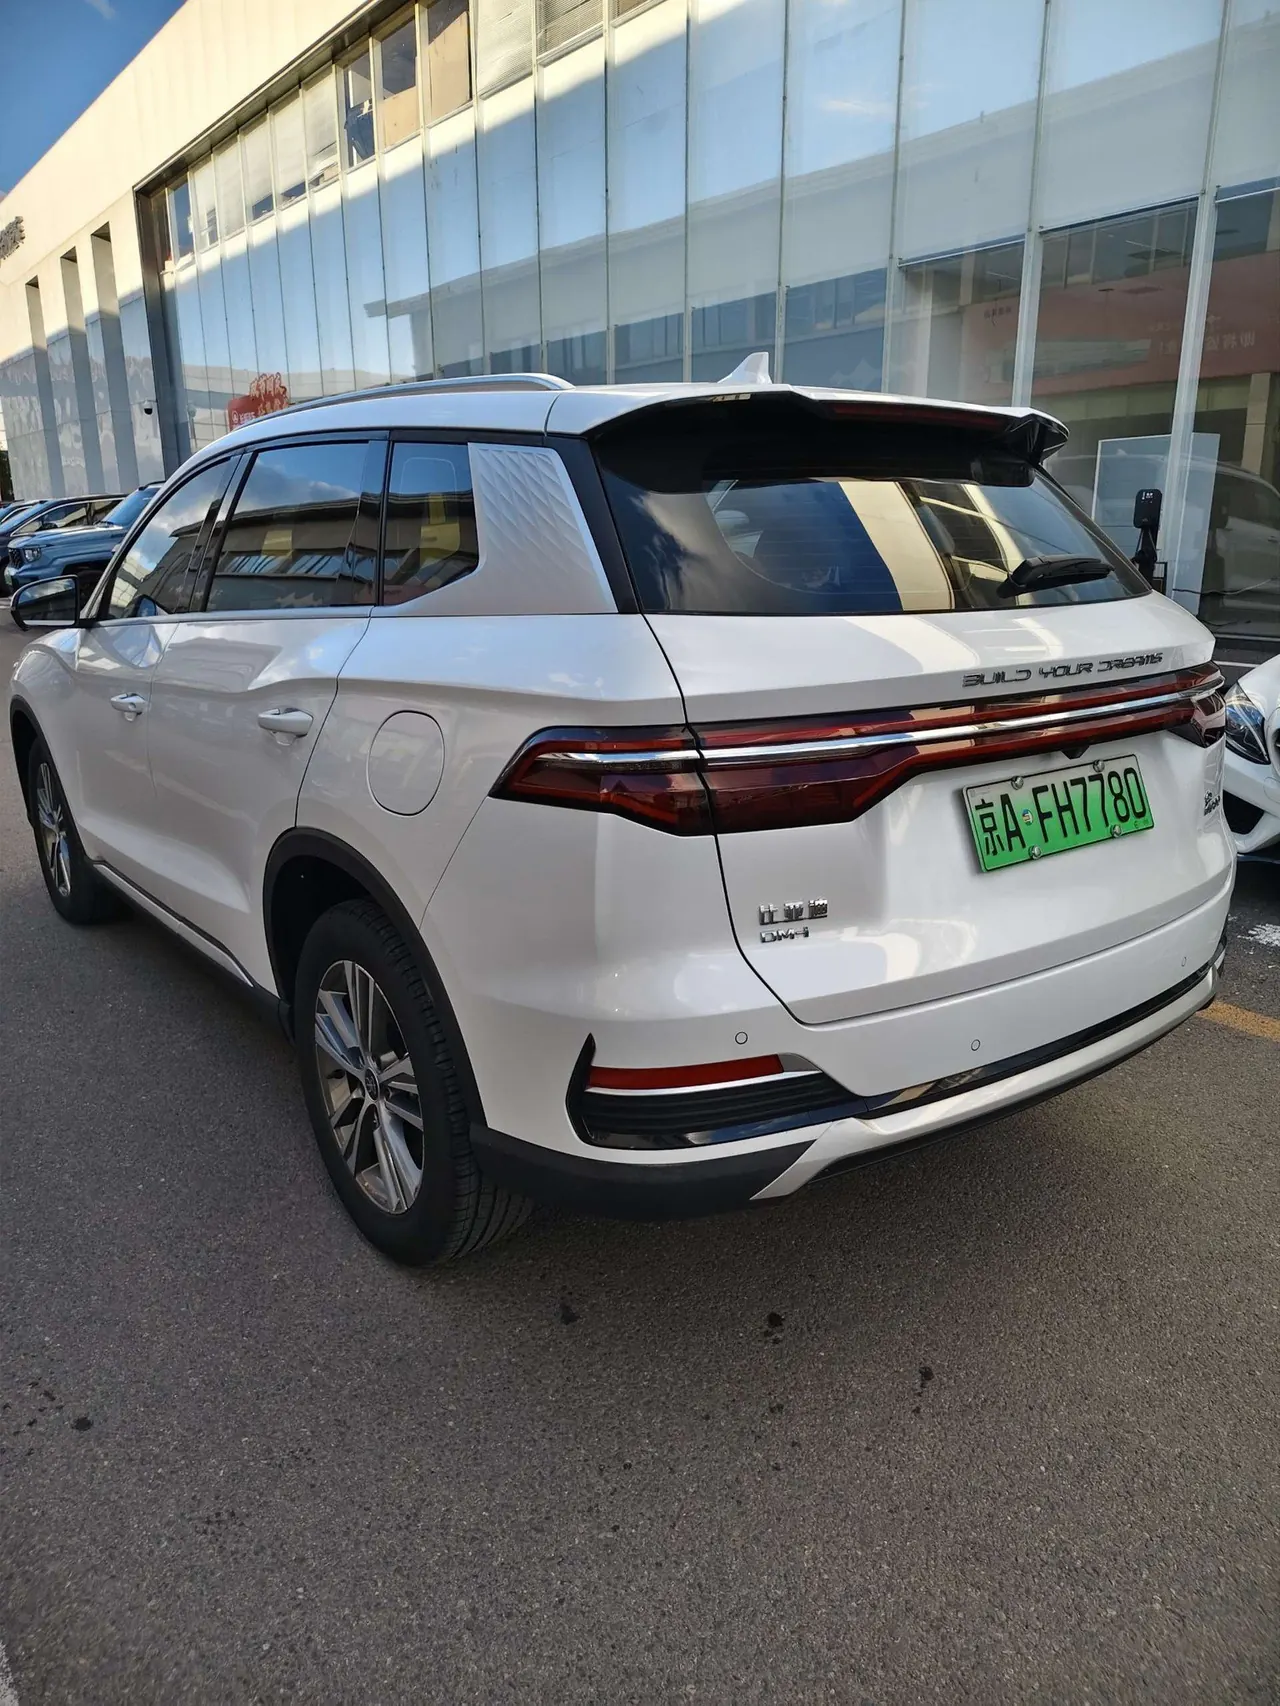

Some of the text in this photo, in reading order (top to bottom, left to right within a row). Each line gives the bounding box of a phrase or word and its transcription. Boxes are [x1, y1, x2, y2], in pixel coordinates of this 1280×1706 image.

[962, 652, 1163, 687] BUILD YOUR DREAMS
[759, 899, 828, 926] 比亚迪
